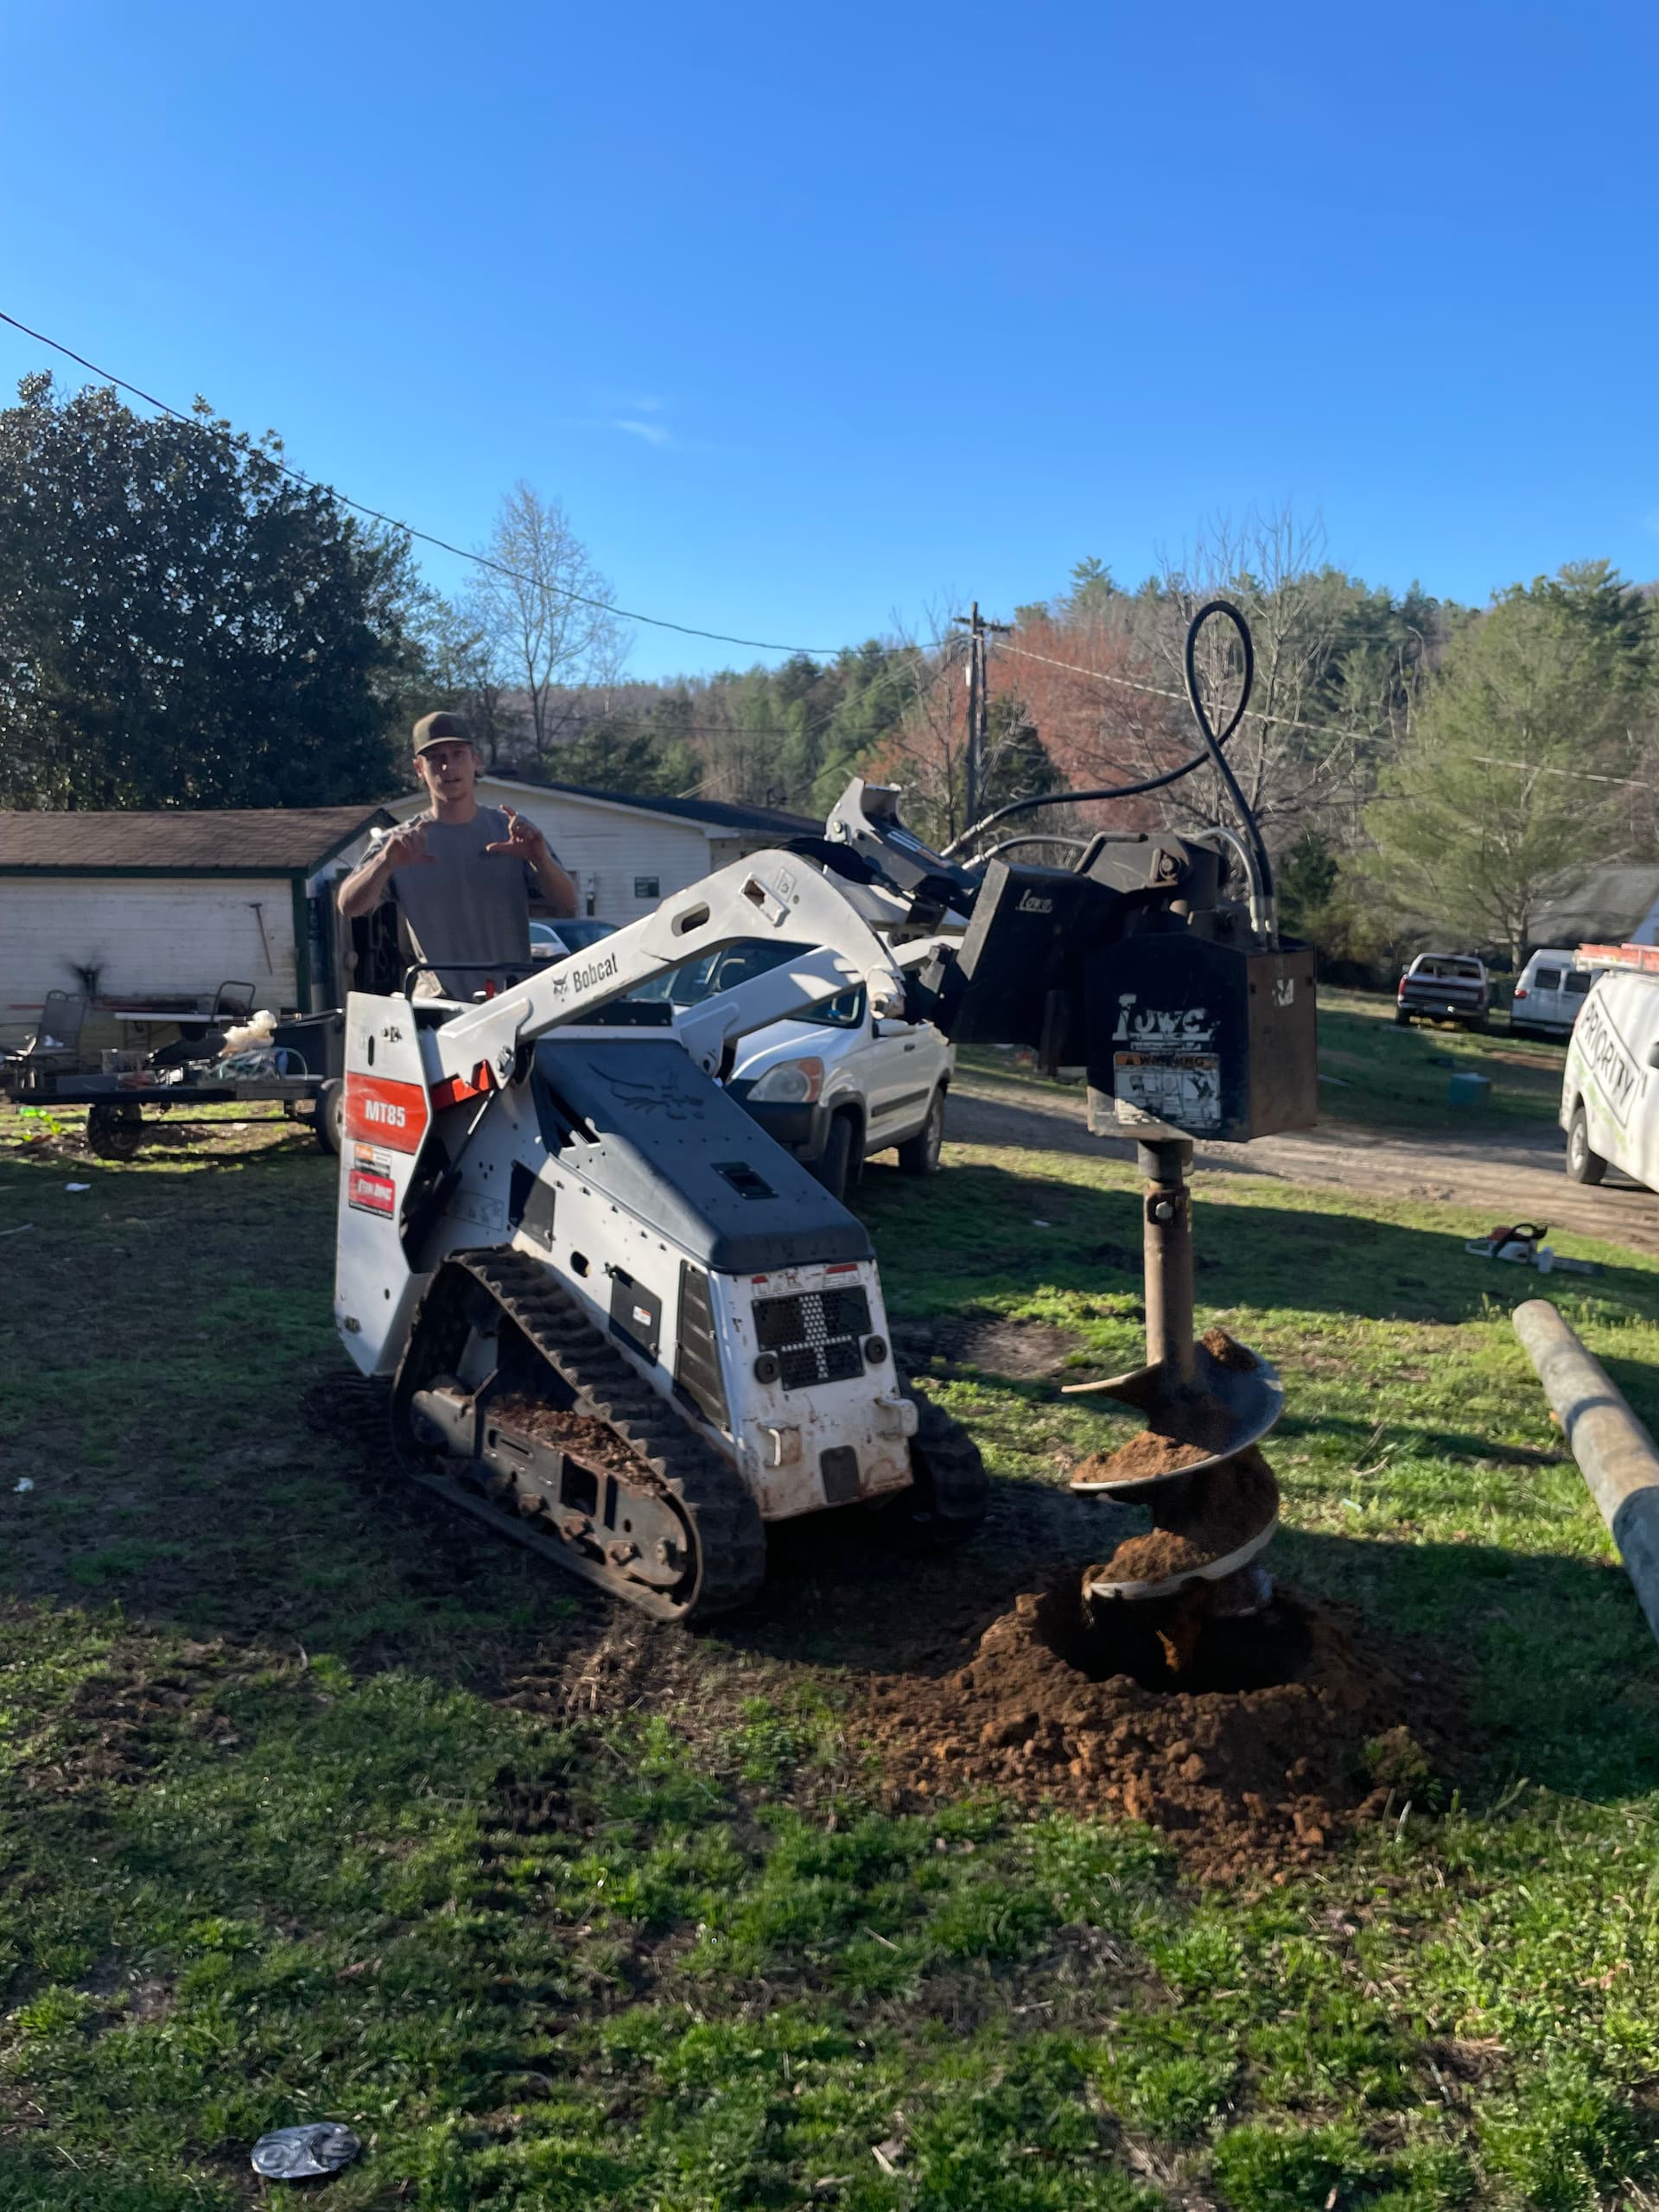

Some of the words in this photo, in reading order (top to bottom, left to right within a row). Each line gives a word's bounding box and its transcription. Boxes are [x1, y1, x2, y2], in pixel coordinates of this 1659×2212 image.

[573, 952, 619, 994] Bobcat
[1140, 1054, 1205, 1069] WANING
[1580, 1000, 1634, 1107] PRIORITY
[365, 1099, 406, 1128] MT85
